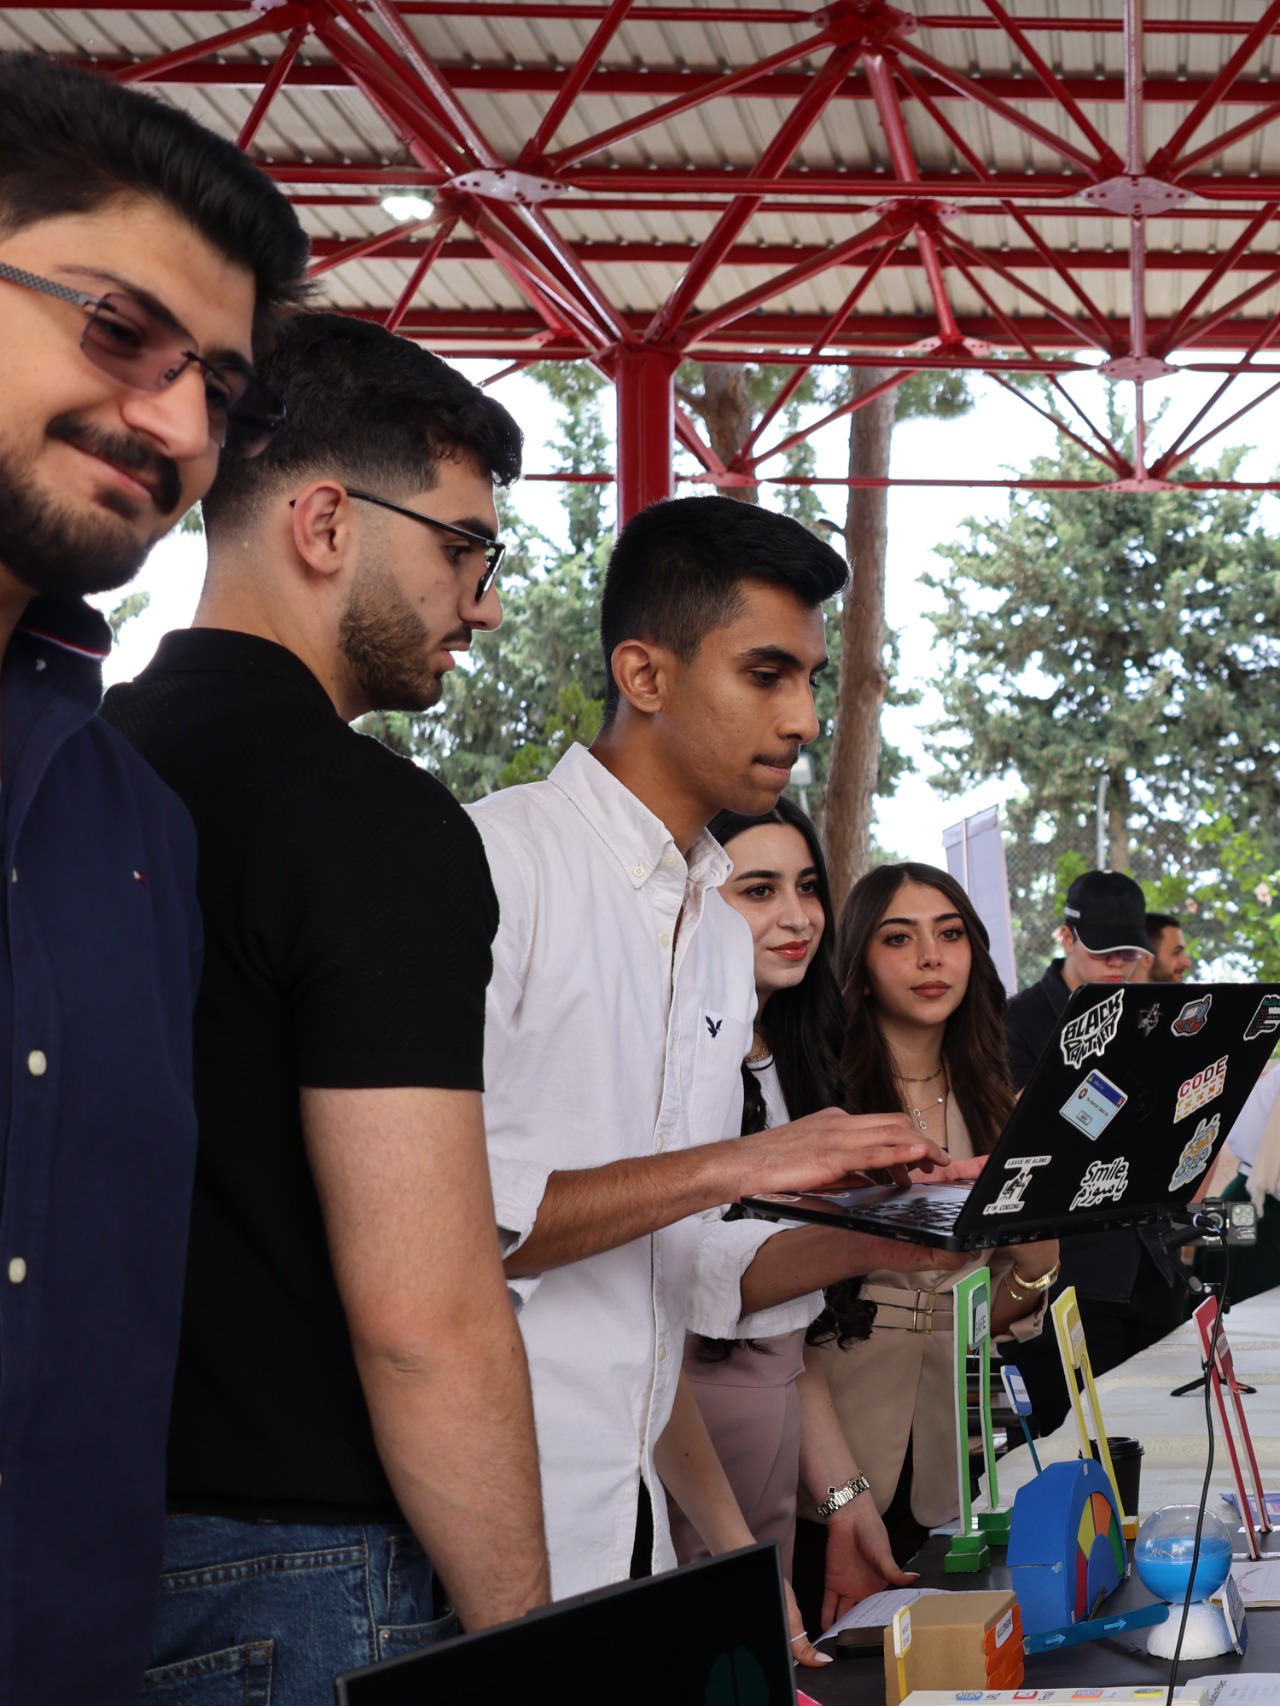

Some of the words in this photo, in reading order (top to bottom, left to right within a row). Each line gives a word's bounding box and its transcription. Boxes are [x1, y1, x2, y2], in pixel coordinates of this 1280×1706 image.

[1064, 992, 1122, 1042] BLACK
[1063, 1009, 1120, 1067] PANTHER
[1180, 1056, 1227, 1098] CODE
[1082, 1158, 1127, 1184] Smile
[1000, 1203, 1023, 1211] CODING!
[975, 1315, 986, 1337] SAFE
